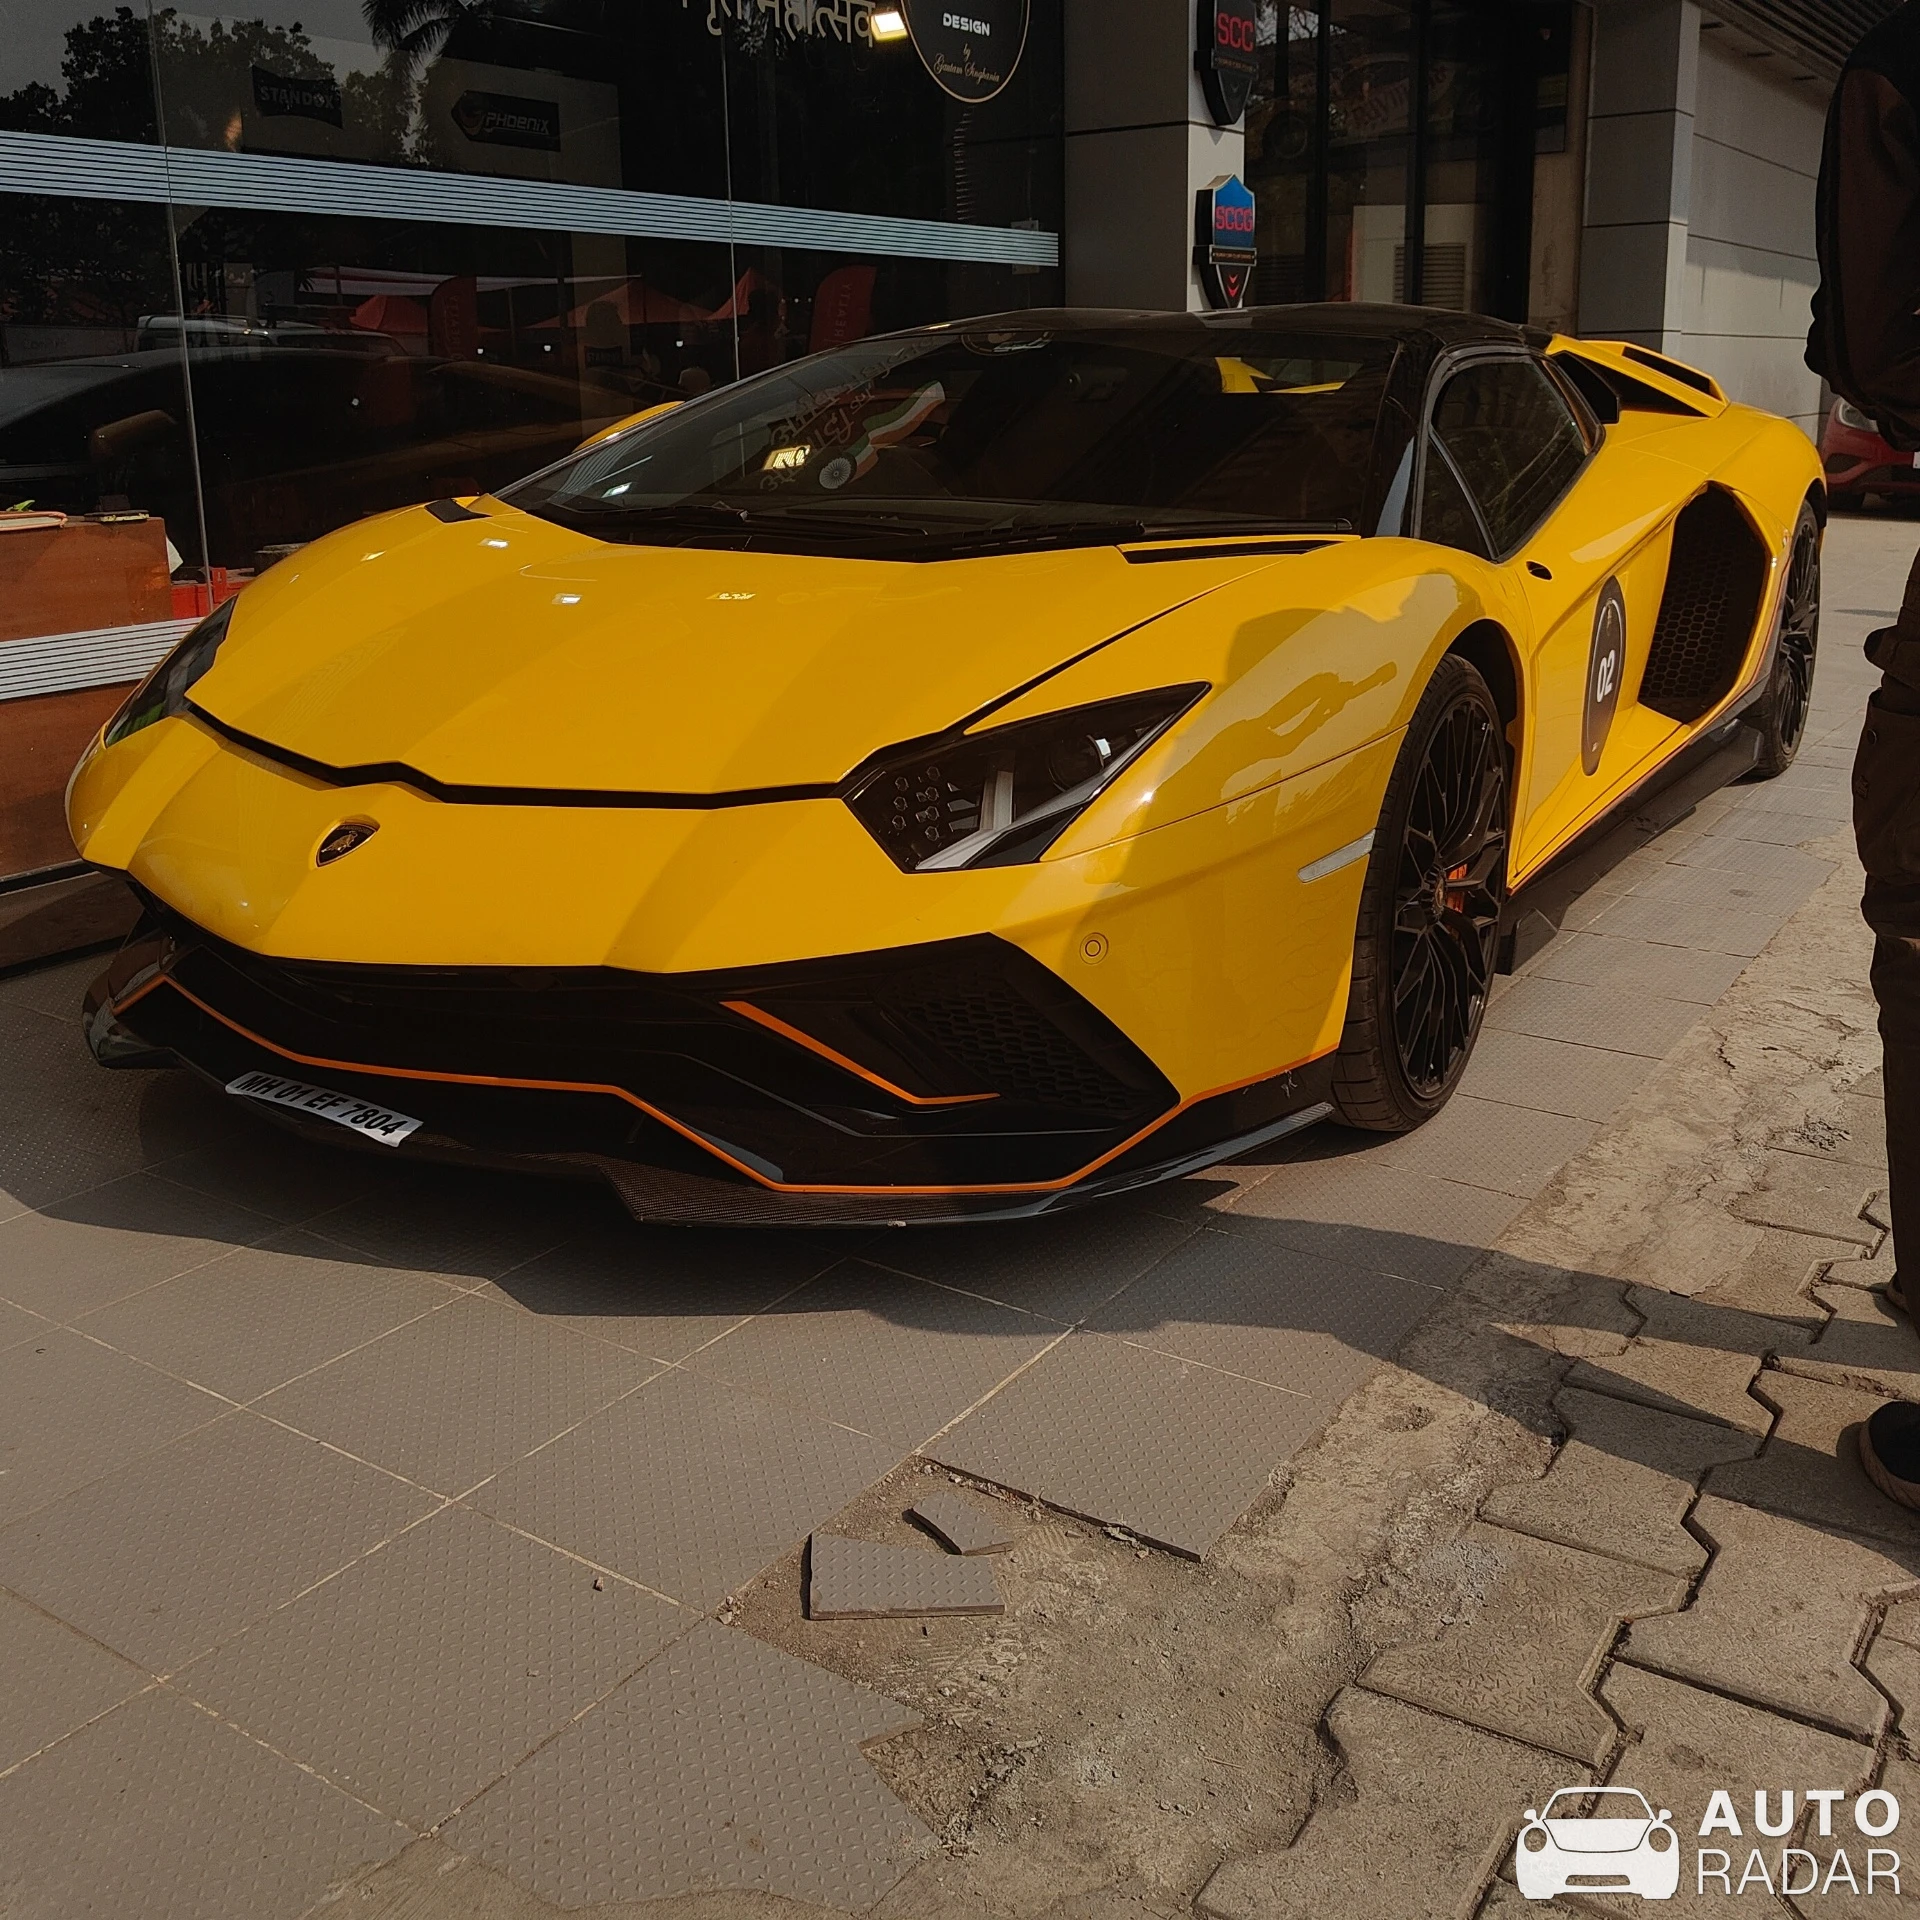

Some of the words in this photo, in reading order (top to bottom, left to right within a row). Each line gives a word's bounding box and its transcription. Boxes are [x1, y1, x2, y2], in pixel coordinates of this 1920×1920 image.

[942, 12, 991, 37] DESIGN
[1217, 12, 1254, 52] SCC
[933, 52, 963, 75] Gautam
[963, 42, 972, 63] by
[259, 84, 335, 110] STANDOX
[1215, 205, 1253, 233] SCCG
[1597, 650, 1615, 702] 02
[236, 1075, 285, 1095] MH
[274, 1085, 314, 1101] 01
[303, 1093, 350, 1111] EF
[337, 1103, 408, 1137] 7804
